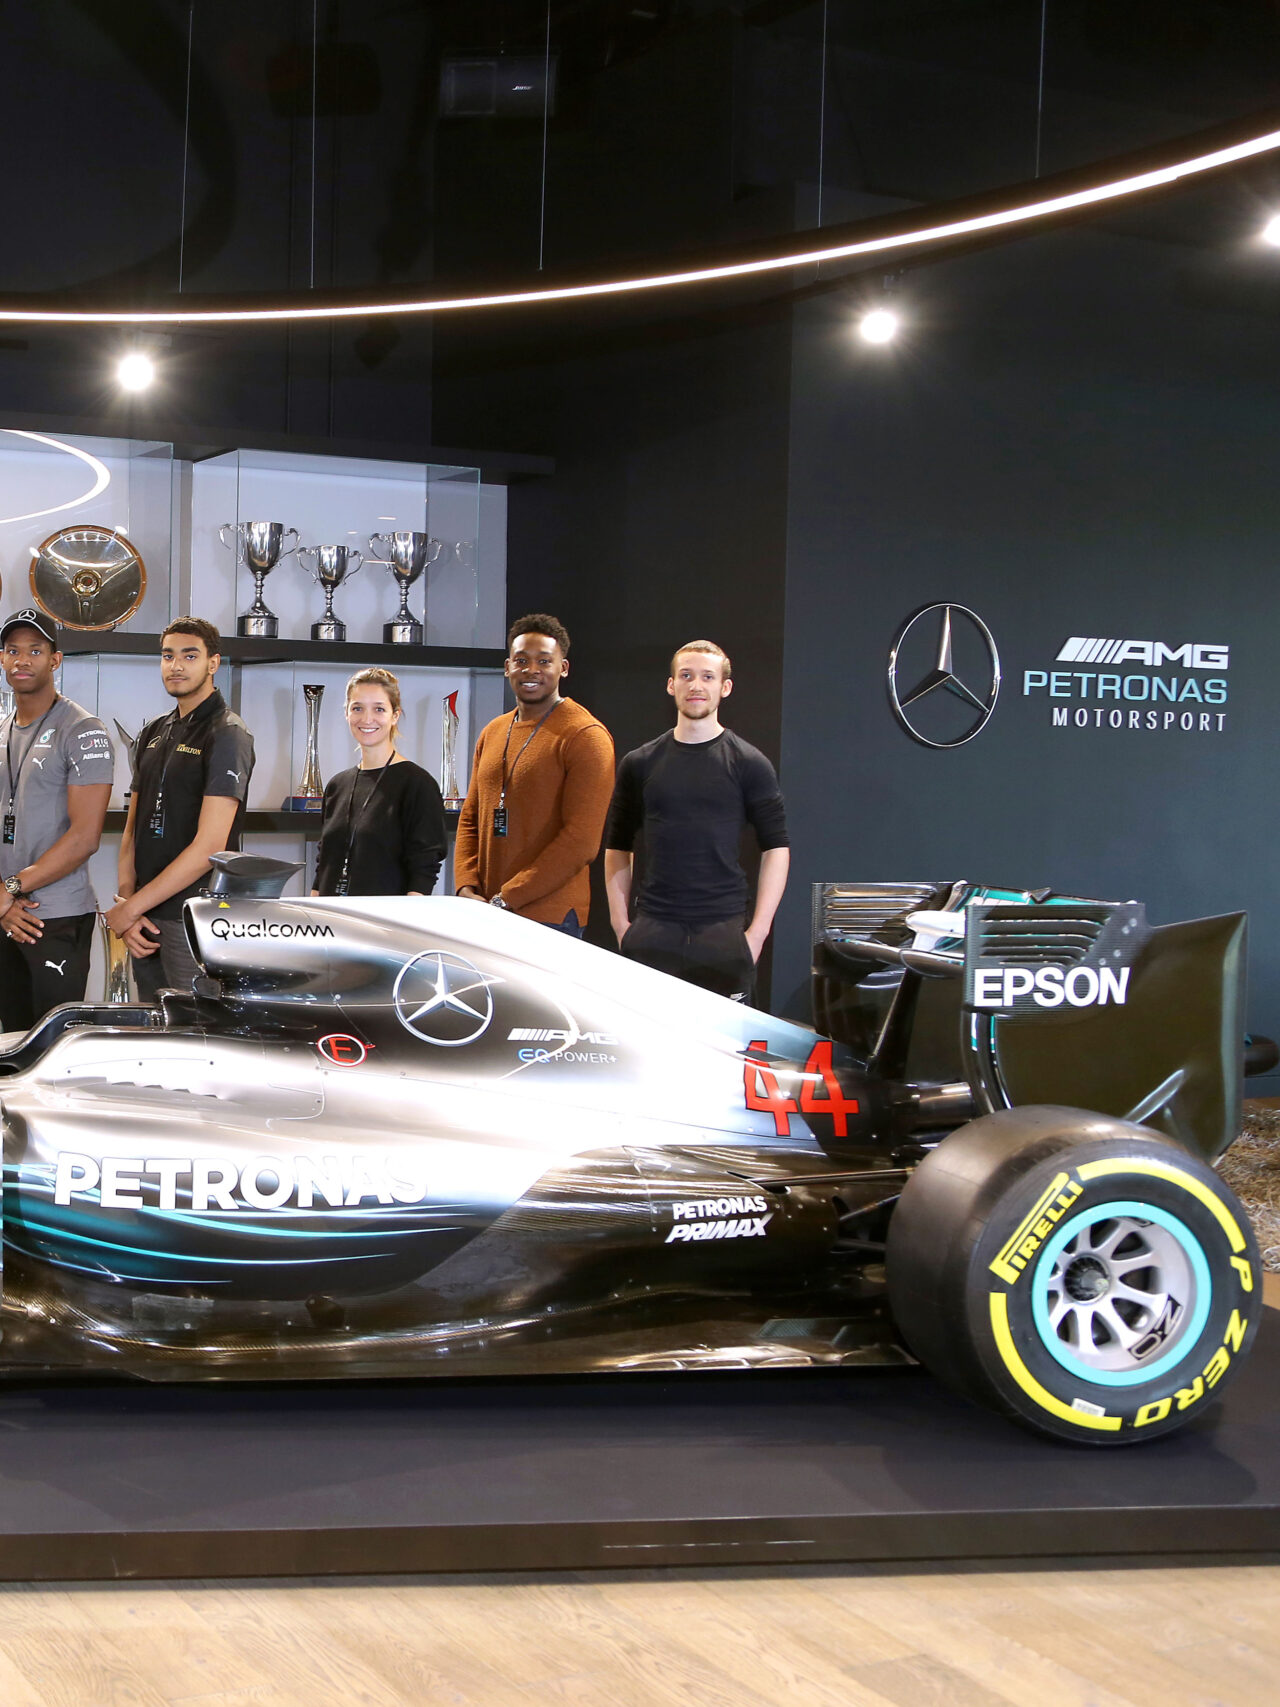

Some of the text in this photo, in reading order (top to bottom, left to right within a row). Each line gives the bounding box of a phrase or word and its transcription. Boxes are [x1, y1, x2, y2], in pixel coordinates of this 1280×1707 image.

[1022, 670, 1228, 705] PETRONAS
[1051, 707, 1227, 732] MOTORSPORT
[211, 917, 335, 941] Qualcomm
[973, 966, 1131, 1008] EPSON
[328, 1037, 356, 1063] E
[744, 1040, 859, 1137] 44
[54, 1151, 428, 1211] PETRONAS
[672, 1195, 768, 1220] PETRONAS
[664, 1213, 774, 1243] PRIMAX
[989, 1172, 1084, 1285] PIRELLI
[1133, 1255, 1253, 1428] P ZERO
